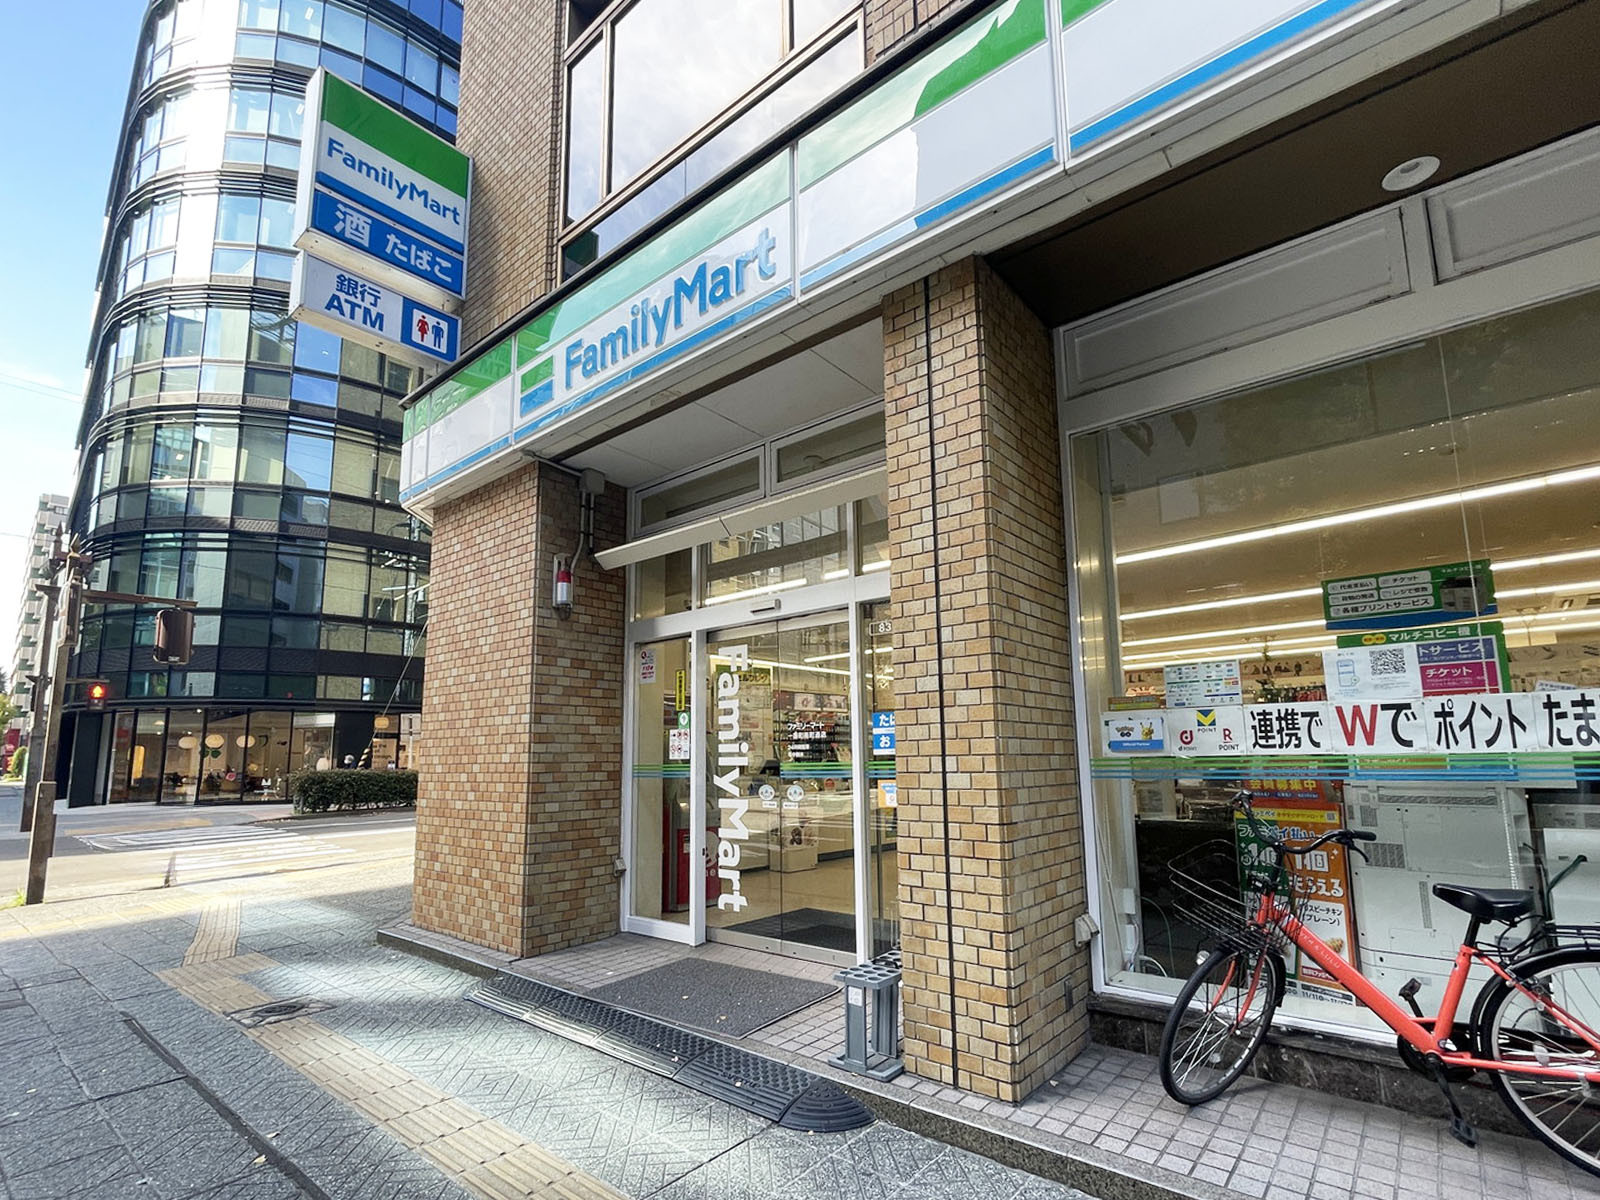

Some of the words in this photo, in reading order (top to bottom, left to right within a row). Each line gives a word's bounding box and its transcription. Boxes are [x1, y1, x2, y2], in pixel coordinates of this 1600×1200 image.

[327, 137, 460, 226] FamilyMart
[333, 204, 372, 248] 酒
[385, 232, 452, 283] たばこ
[336, 274, 381, 307] 銀行
[325, 294, 384, 332] ATM
[564, 227, 777, 390] FamilyMart
[1392, 575, 1419, 584] チケット
[1342, 597, 1431, 614] 各種プリントサービス
[1389, 627, 1471, 643] マルチコピー機
[1425, 666, 1473, 679] チケット
[787, 721, 825, 730] ファミリーマート
[1251, 709, 1323, 750] 連携で
[1335, 702, 1418, 748] Wで
[1433, 698, 1528, 750] ポイント
[1218, 744, 1240, 752] POINT
[714, 643, 749, 913] FamilyMart
